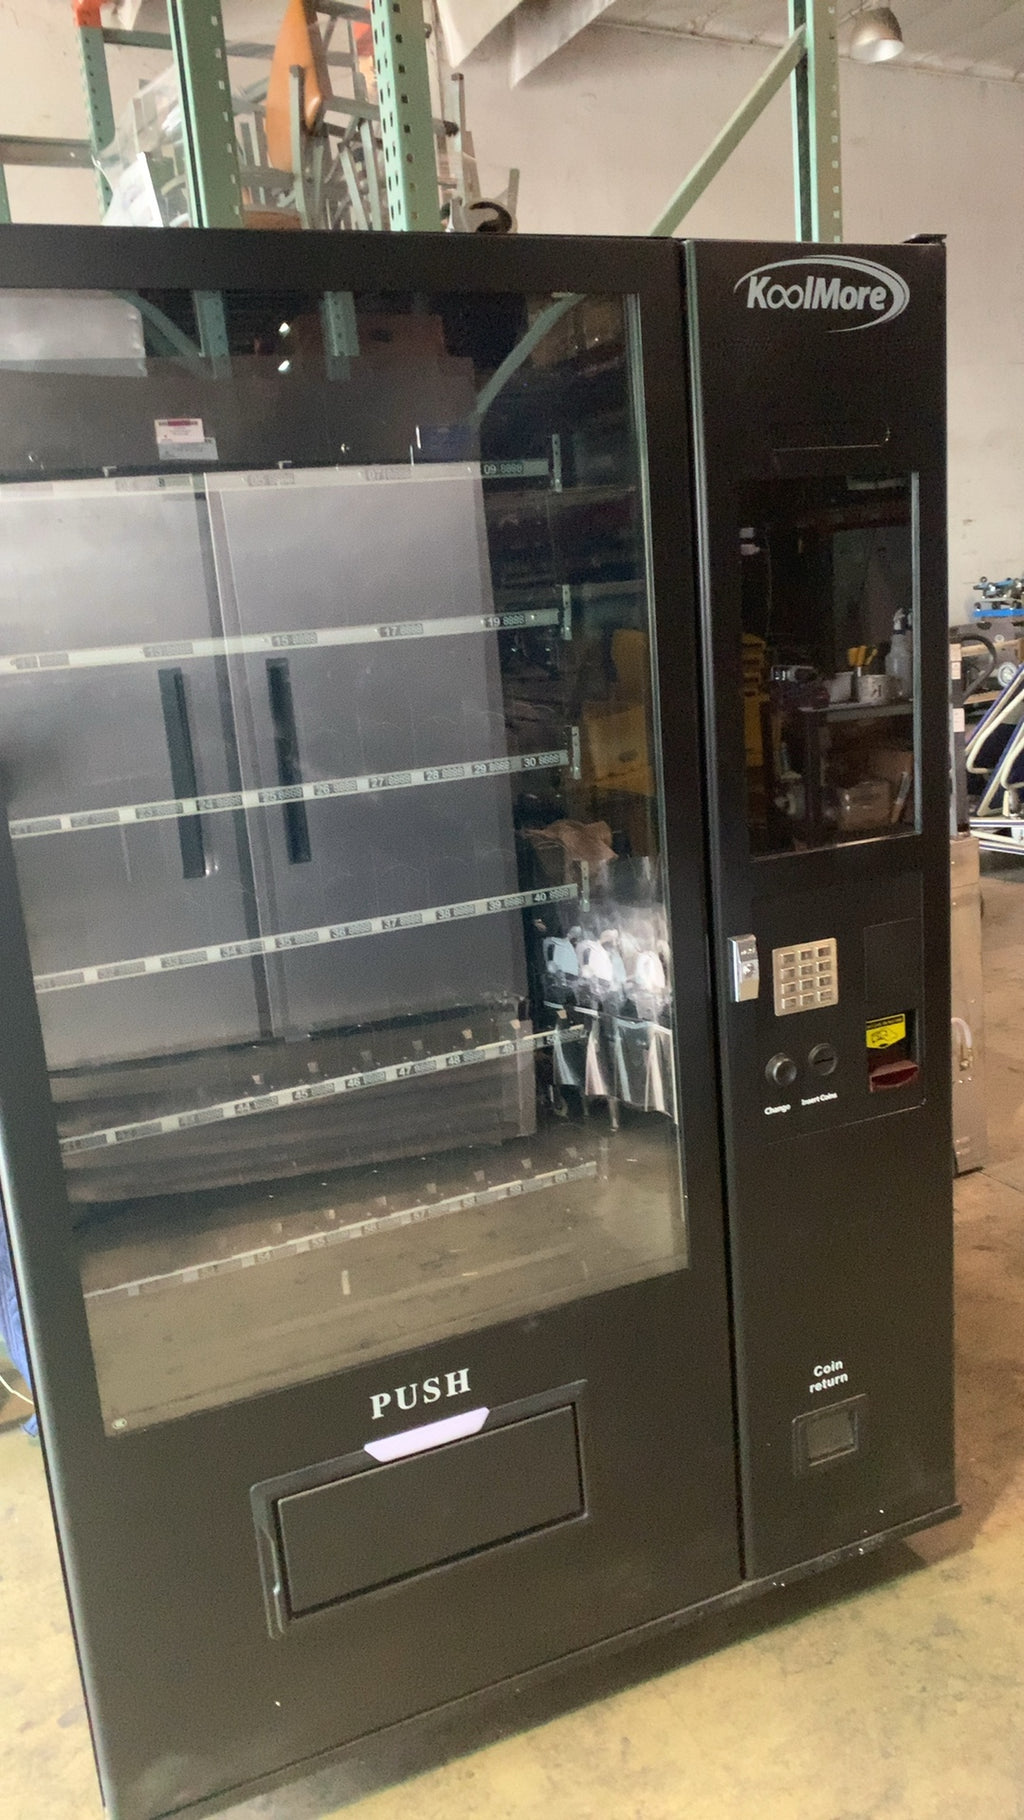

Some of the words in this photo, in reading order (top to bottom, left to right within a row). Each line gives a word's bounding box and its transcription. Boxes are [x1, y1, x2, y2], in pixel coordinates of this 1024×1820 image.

[747, 275, 887, 311] KoolMore
[484, 464, 497, 474] 09
[385, 626, 398, 637] 17
[489, 617, 501, 627] 19
[474, 764, 487, 774] 29
[523, 757, 537, 767] 30
[534, 892, 547, 902] 40
[398, 1065, 412, 1077] 47
[813, 1360, 844, 1377] Coin
[809, 1373, 849, 1394] return
[369, 1367, 472, 1420] PUSH
